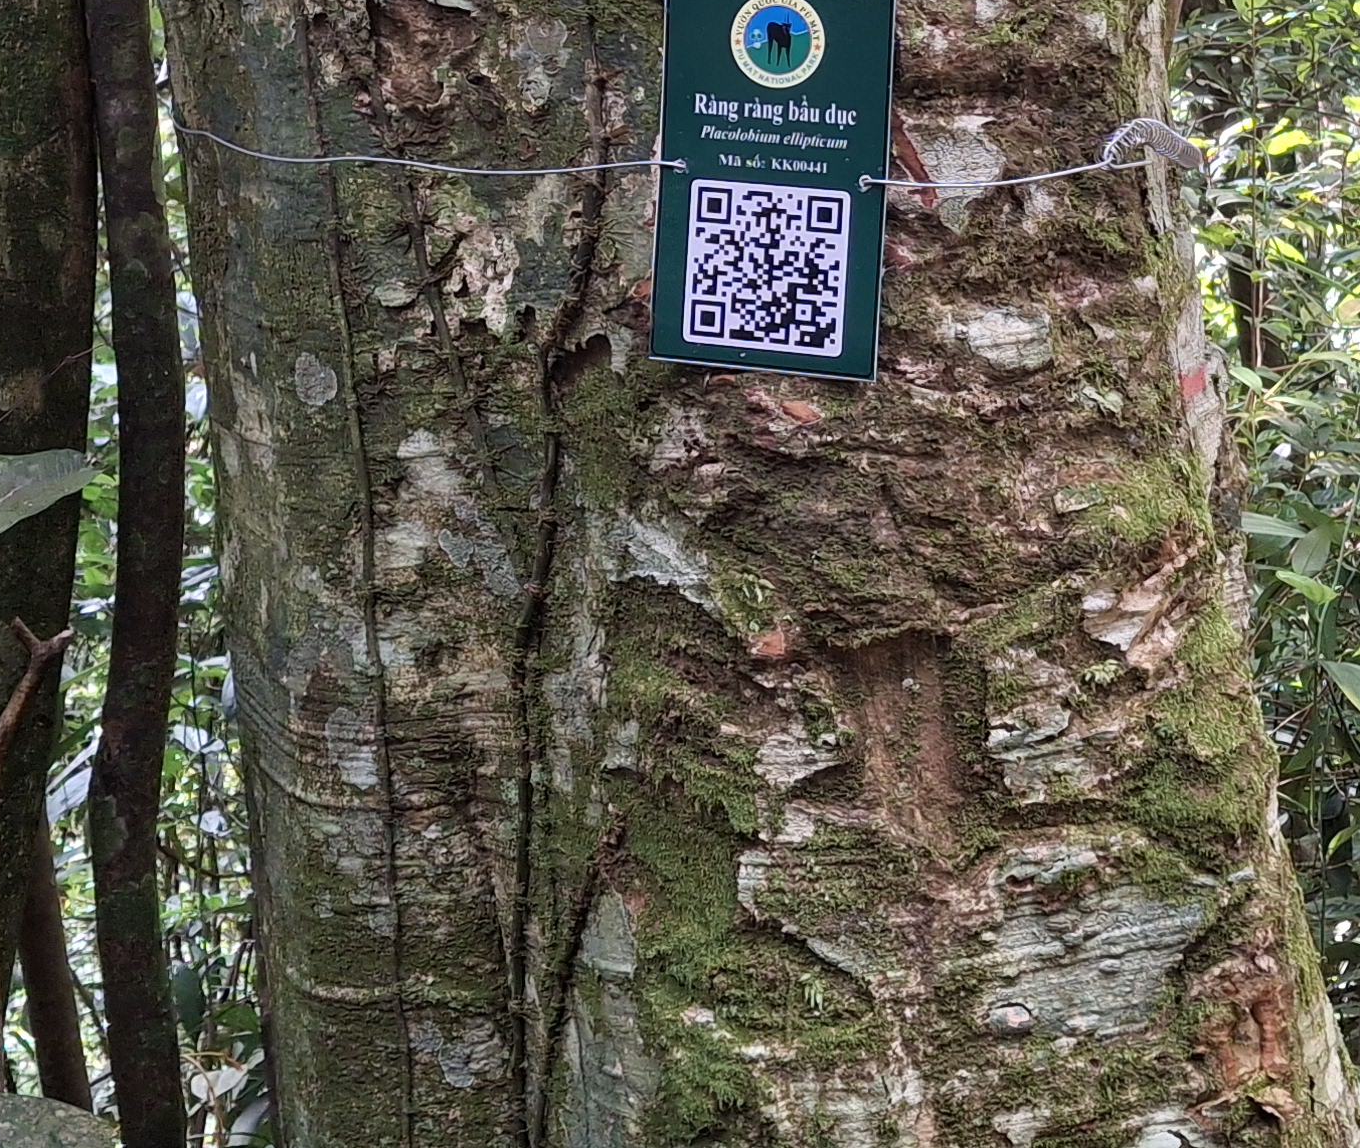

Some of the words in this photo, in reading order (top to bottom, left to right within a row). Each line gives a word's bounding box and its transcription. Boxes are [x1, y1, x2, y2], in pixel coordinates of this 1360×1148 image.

[736, 49, 746, 61] PU
[742, 60, 759, 76] MAT
[758, 72, 804, 85] NATIONAL
[801, 52, 820, 75] PARK
[826, 103, 857, 130] dục
[701, 125, 781, 144] Placolobium
[784, 131, 848, 149] ellipticum
[718, 153, 742, 167] Mã
[745, 153, 766, 169] số:
[770, 157, 829, 174] KK00441
